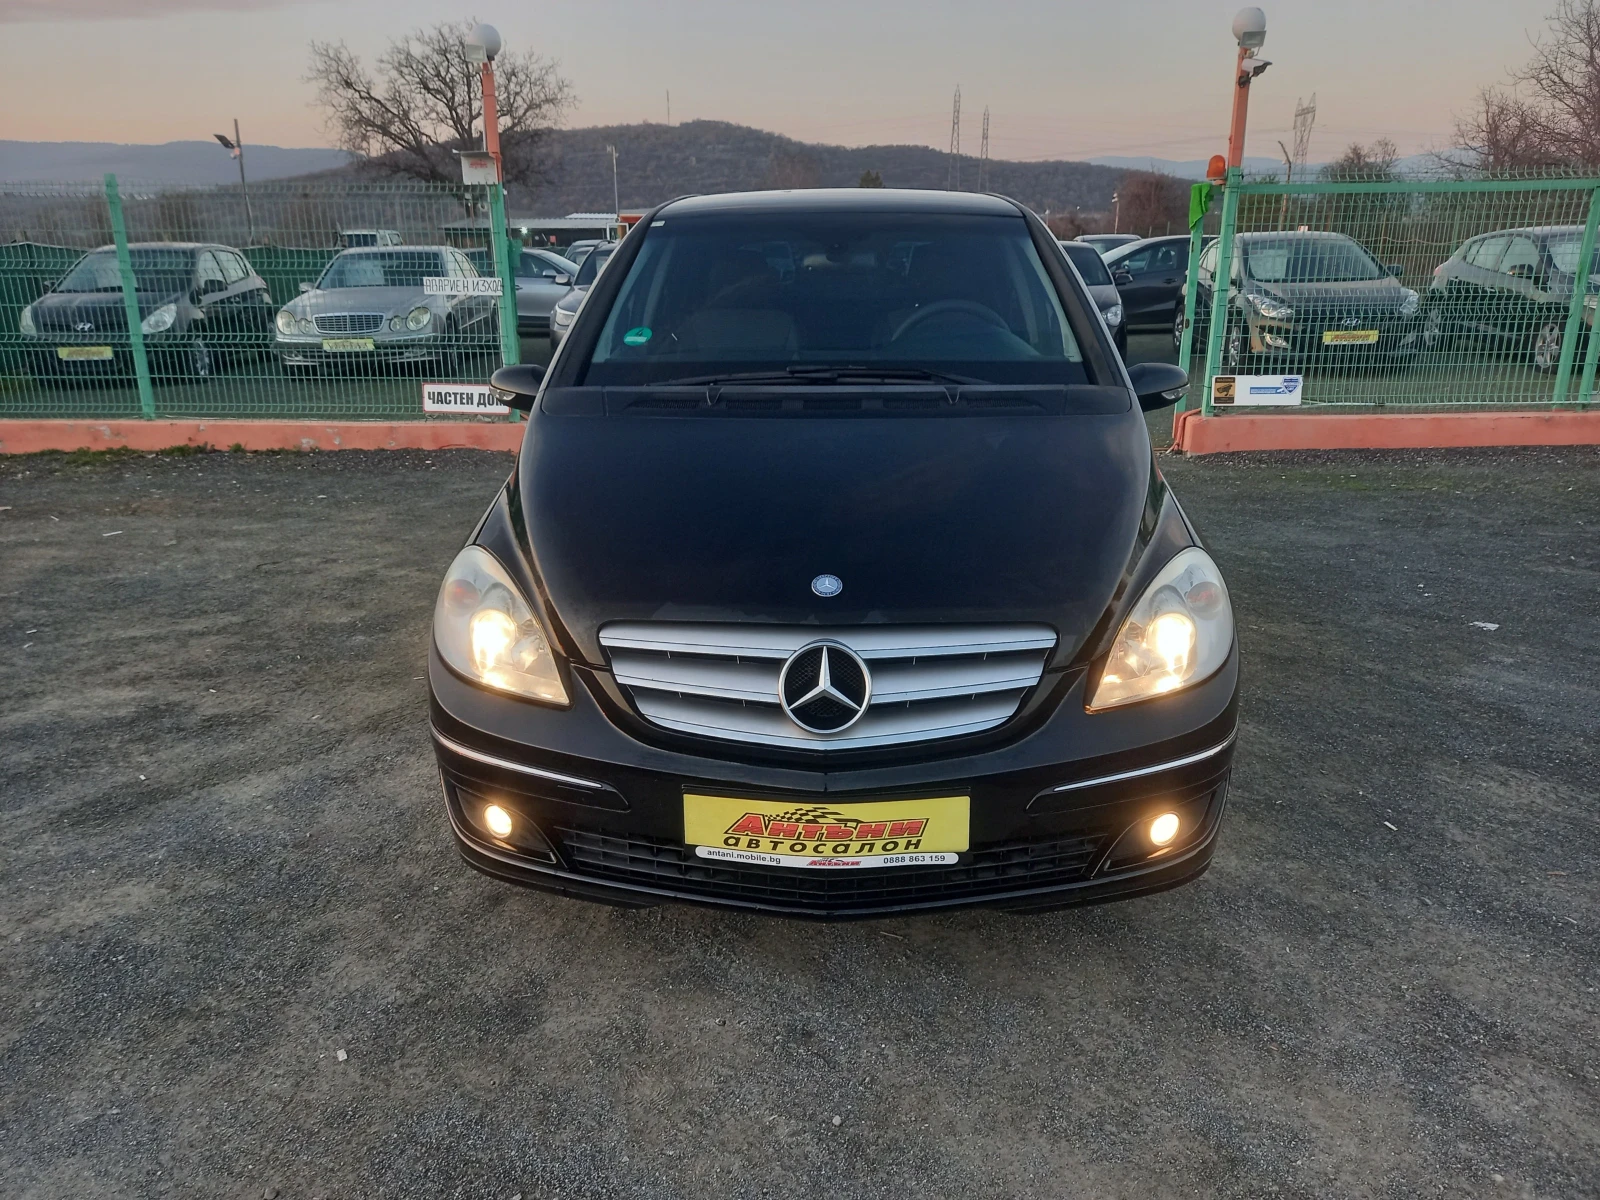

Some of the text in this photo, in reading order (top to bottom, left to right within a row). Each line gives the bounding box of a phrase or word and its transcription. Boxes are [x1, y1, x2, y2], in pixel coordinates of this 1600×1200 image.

[425, 279, 503, 292] АВАРИЕН ИЗХОД
[427, 391, 474, 405] ЧАСТЕН
[723, 836, 921, 854] автосалон
[707, 849, 781, 864] antani.mobile.bg
[909, 855, 926, 863] 863
[929, 854, 946, 862] 159
